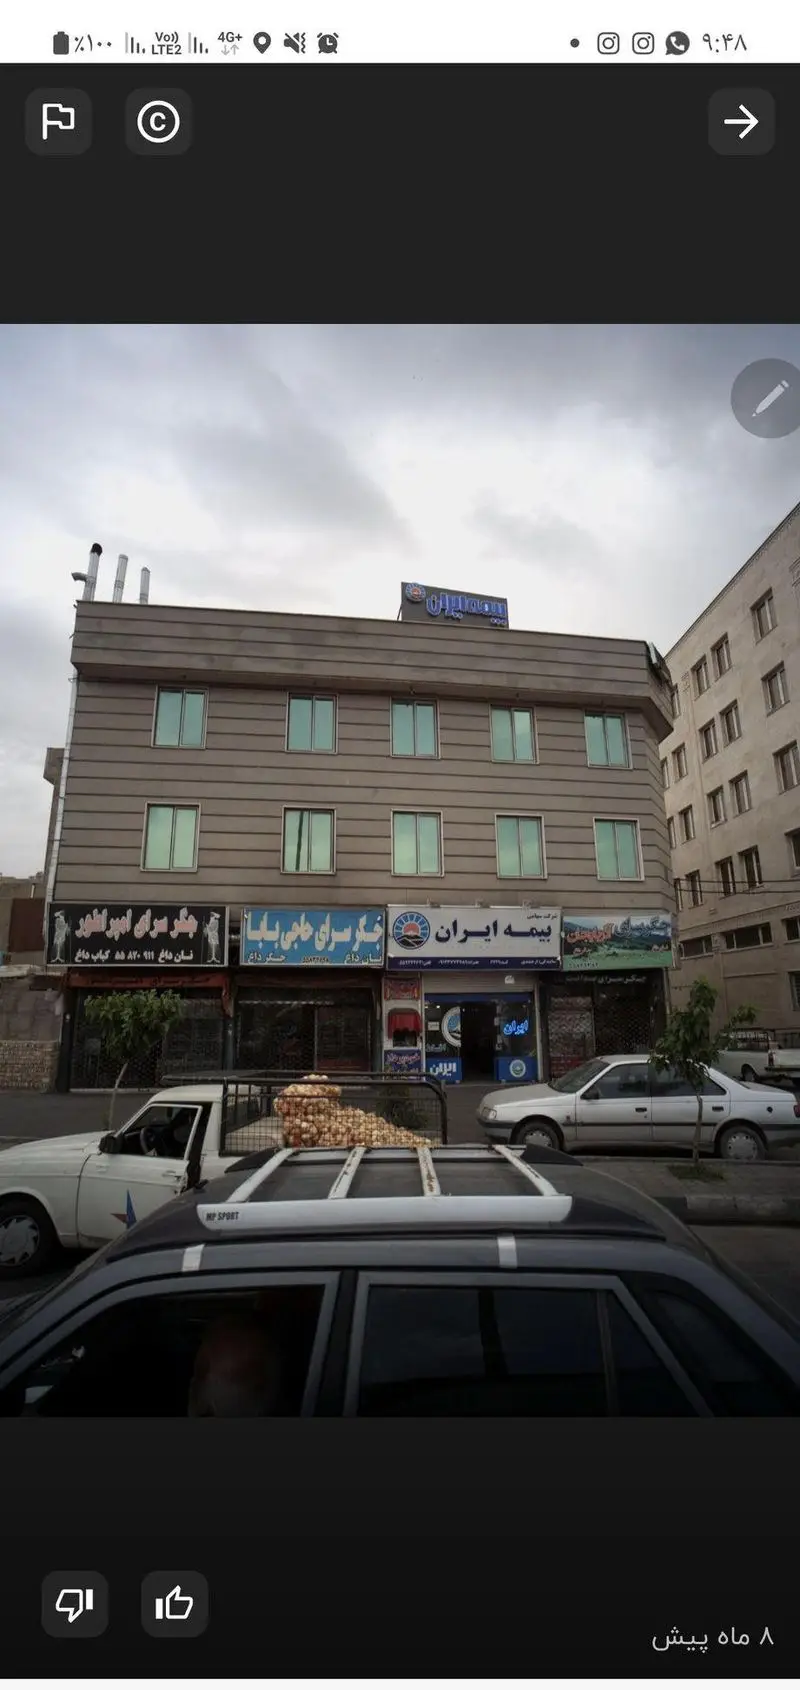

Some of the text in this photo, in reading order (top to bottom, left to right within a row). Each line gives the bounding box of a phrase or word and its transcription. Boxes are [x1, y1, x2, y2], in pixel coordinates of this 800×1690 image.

[426, 592, 467, 619] ایران
[134, 908, 168, 939] سرای
[315, 912, 352, 951] سرای
[434, 918, 552, 944] بیمه ایران
[74, 948, 90, 963] داغ
[157, 949, 173, 963] داغ
[502, 1019, 529, 1036] ایران
[430, 1062, 457, 1077] ایران
